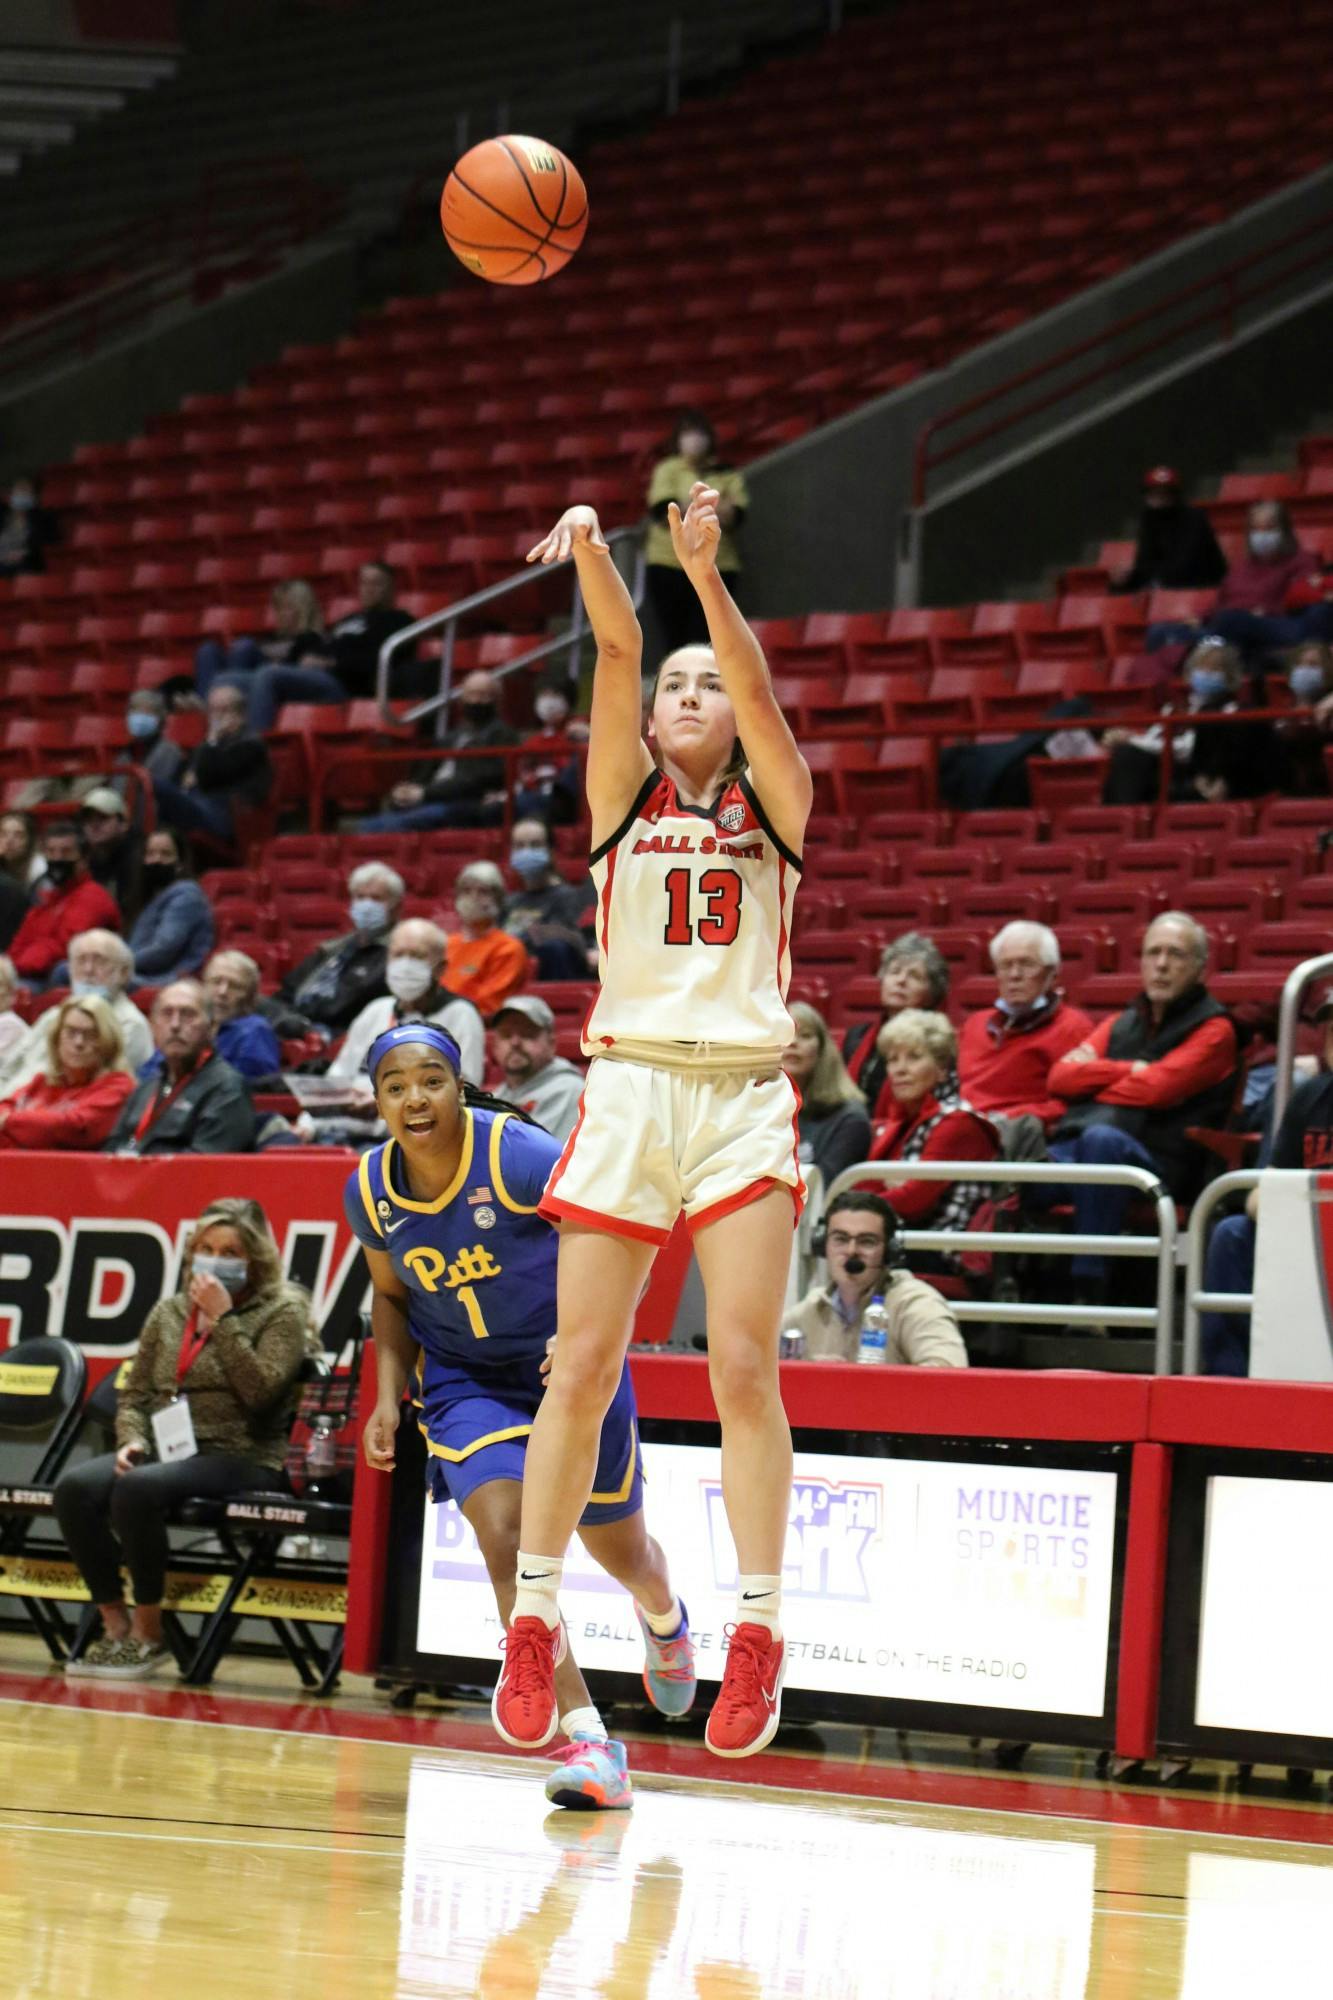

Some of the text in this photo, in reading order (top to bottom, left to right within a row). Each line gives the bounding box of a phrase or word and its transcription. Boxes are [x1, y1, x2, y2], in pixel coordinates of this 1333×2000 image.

[664, 868, 743, 946] 13
[402, 1243, 503, 1293] Pitt
[456, 1286, 490, 1339] 1
[13, 1488, 54, 1505] STATE
[226, 1502, 307, 1524] BALL STATE
[957, 1487, 1093, 1529] MUNCIE
[583, 1621, 637, 1642] BALL
[914, 1653, 952, 1672] THE
[960, 1657, 1028, 1680] RADIO
